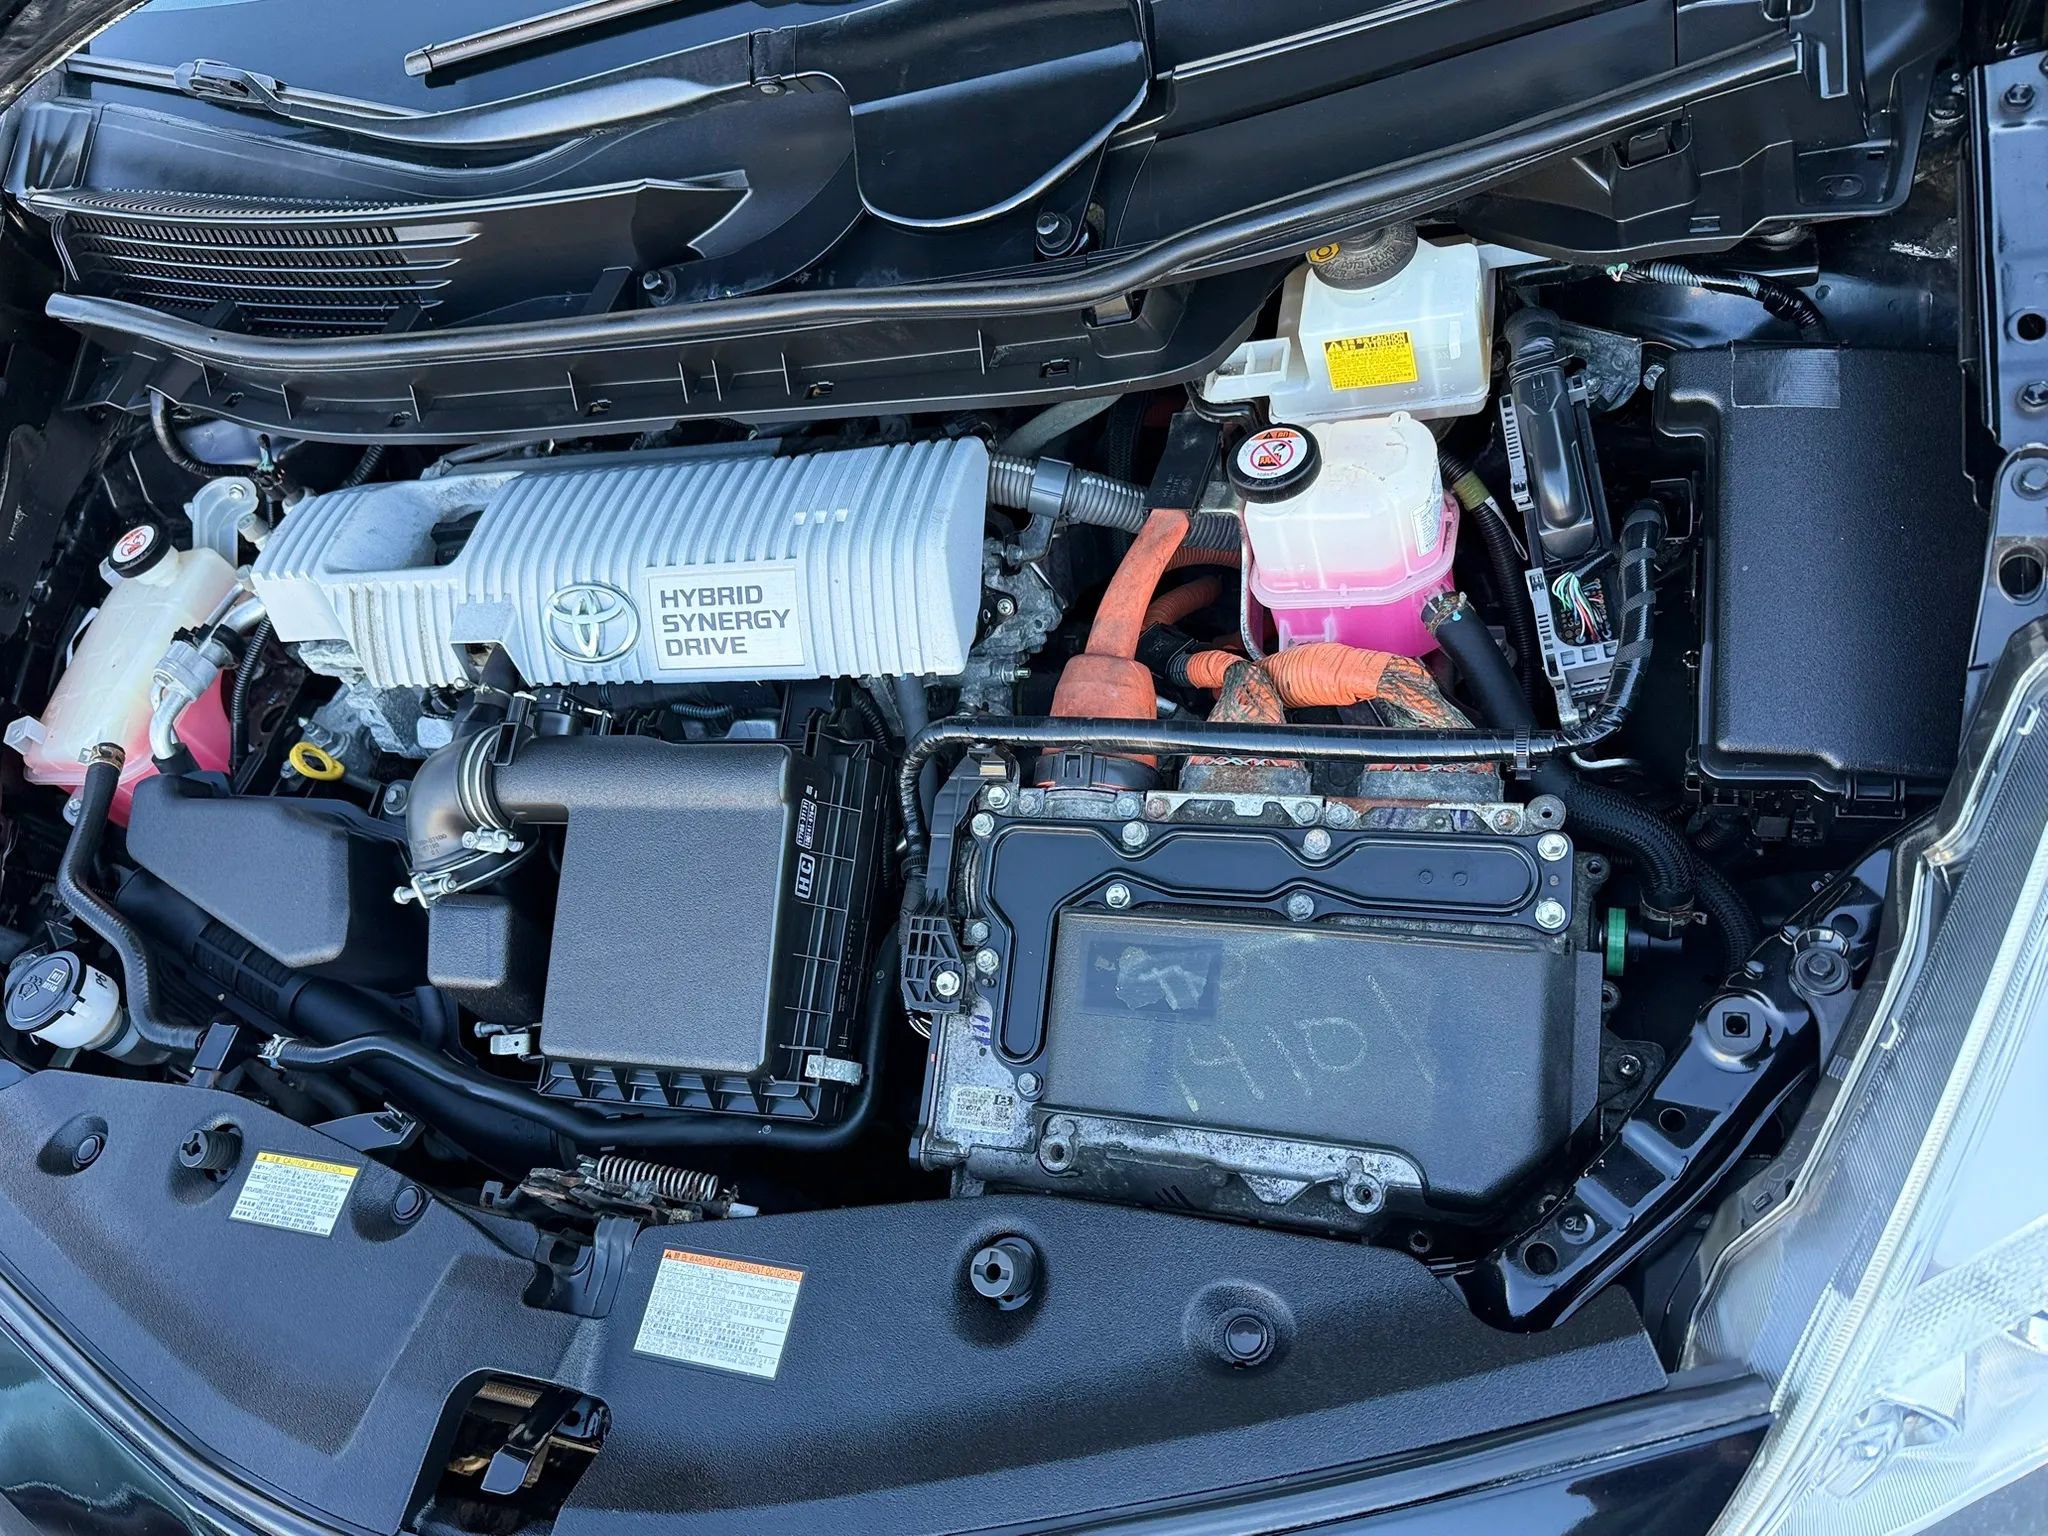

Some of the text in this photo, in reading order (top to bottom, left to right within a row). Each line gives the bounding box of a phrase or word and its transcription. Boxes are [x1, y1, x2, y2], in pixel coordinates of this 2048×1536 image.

[1370, 331, 1405, 343] CAUTION
[660, 584, 763, 609] HYBRID
[662, 608, 791, 633] SYNERGY
[665, 636, 748, 657] DRIVE
[283, 1157, 308, 1169] CAUTION
[309, 1161, 342, 1173] ATTENTION
[717, 1258, 765, 1276] AVERTISSEMENT
